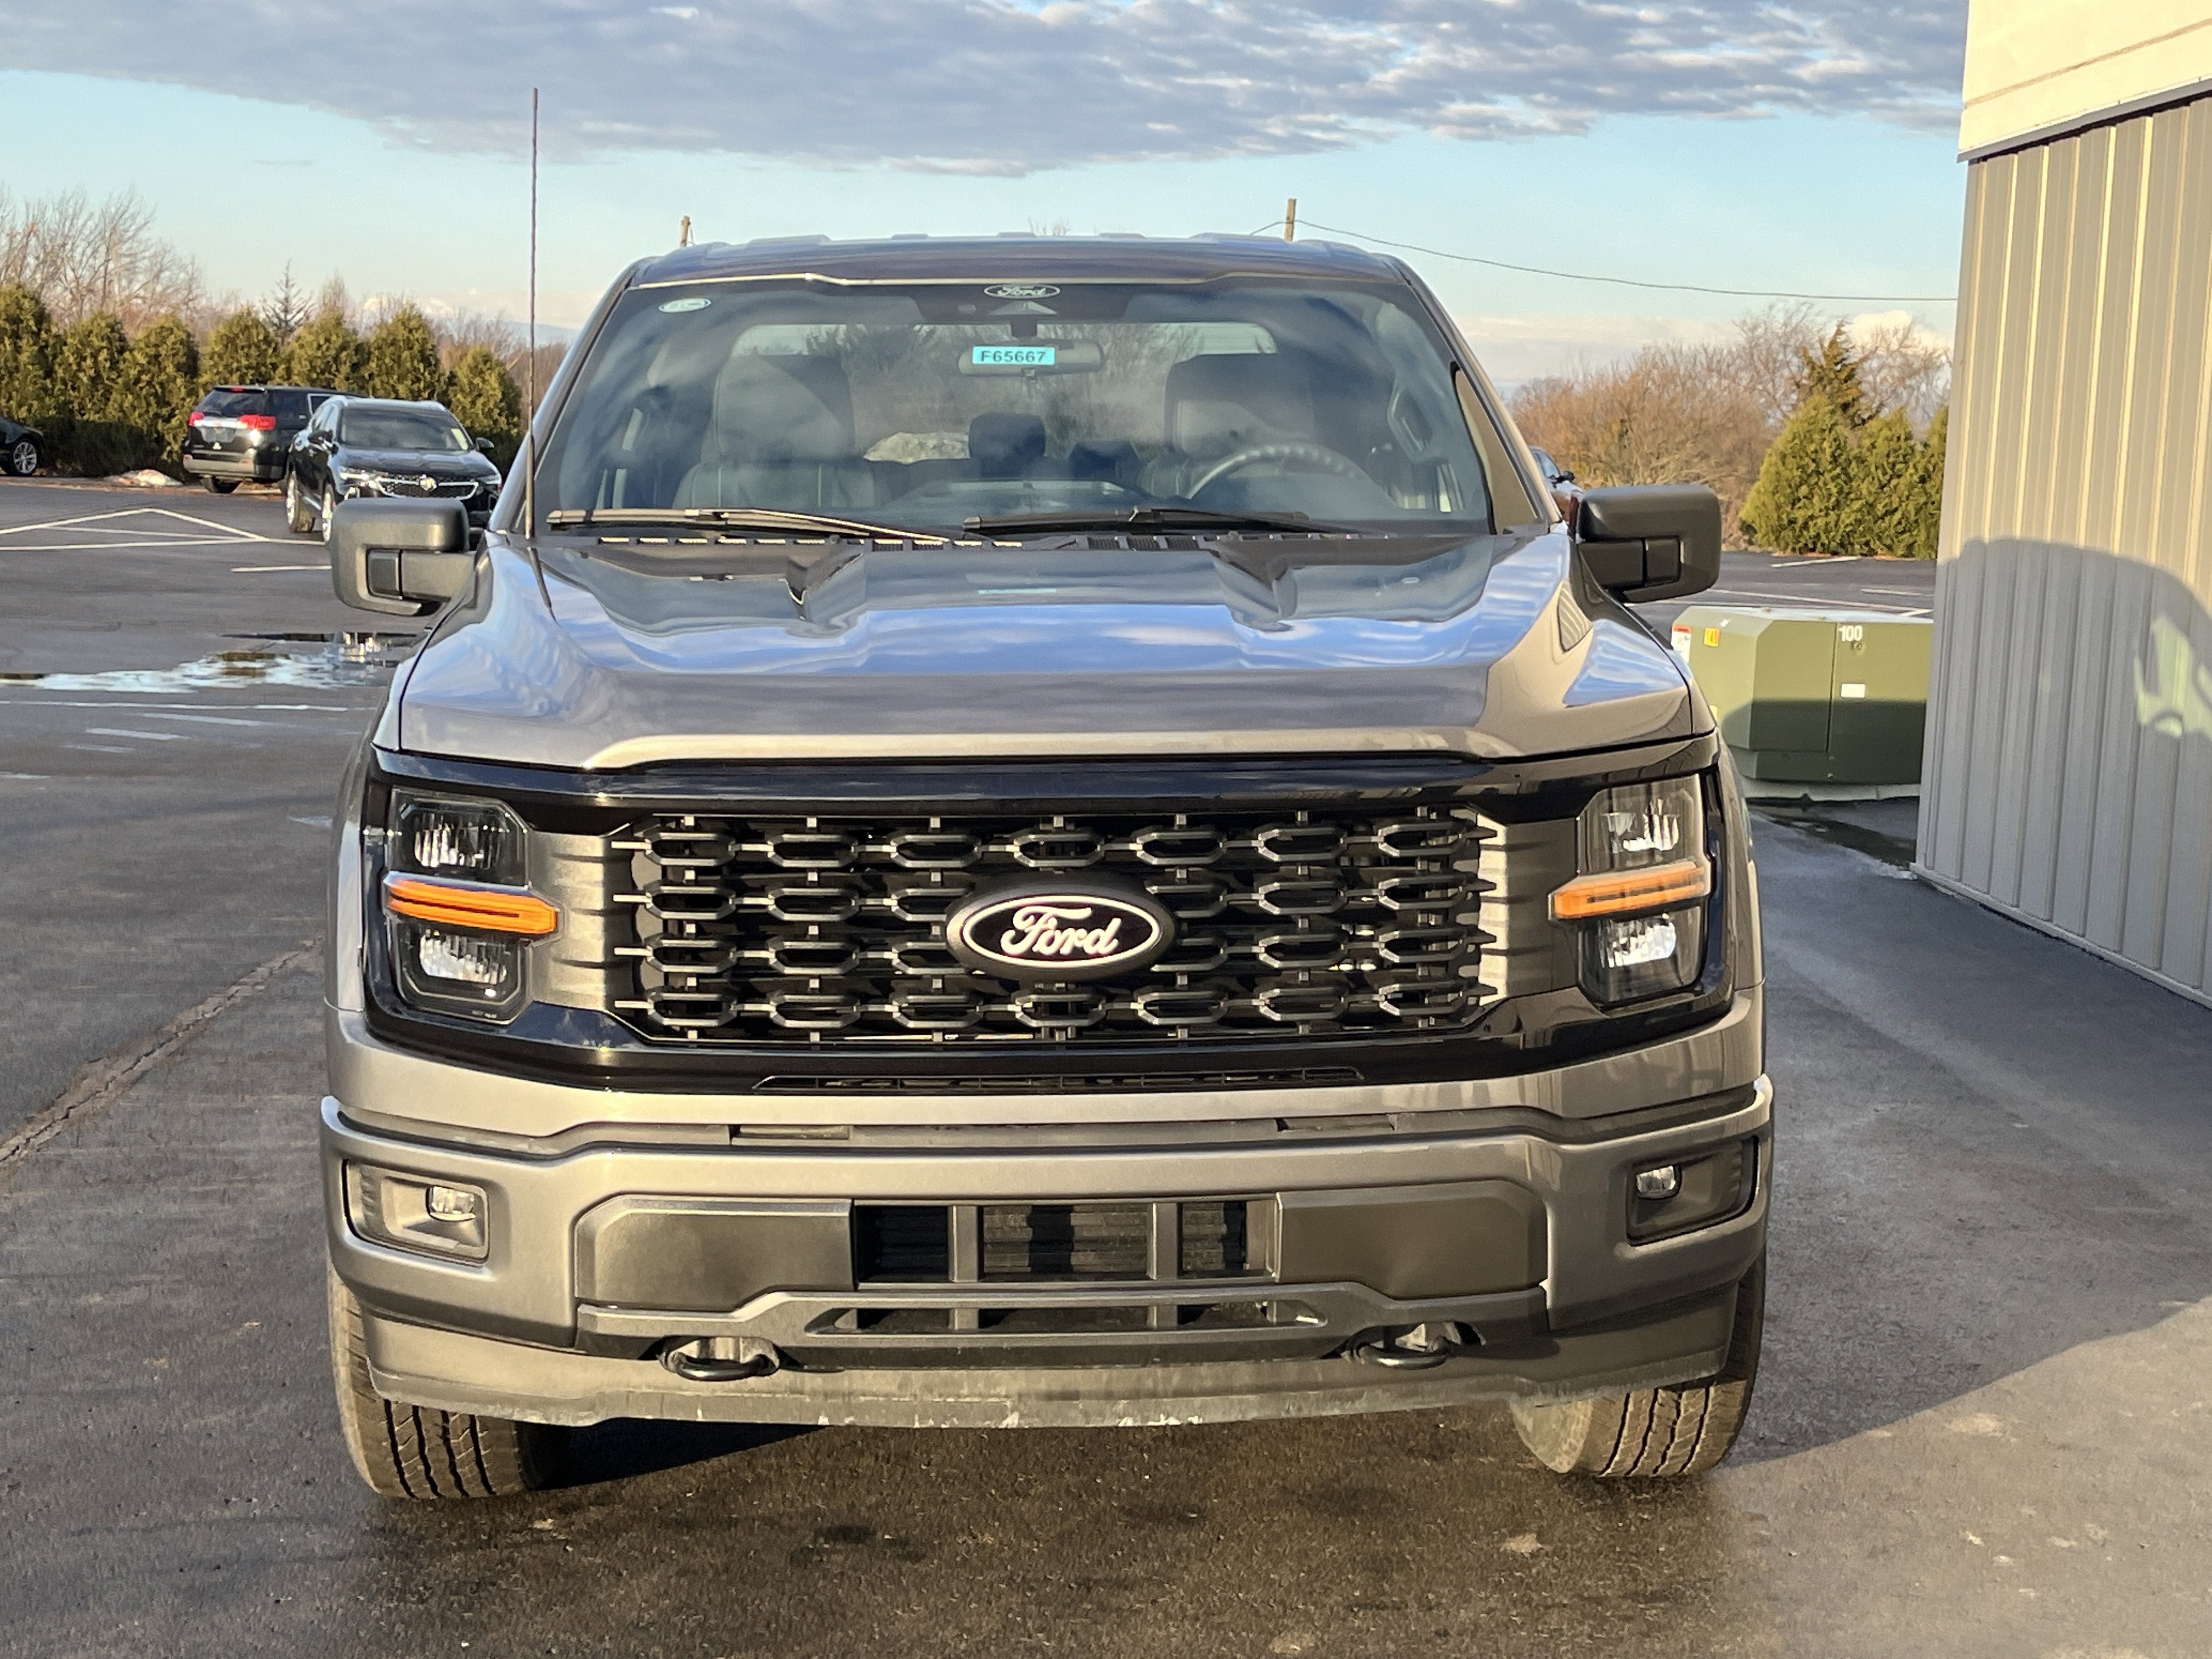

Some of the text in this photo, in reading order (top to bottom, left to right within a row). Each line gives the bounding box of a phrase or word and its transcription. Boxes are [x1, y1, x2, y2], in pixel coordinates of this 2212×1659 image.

[997, 285, 1047, 297] Ford
[980, 351, 1046, 362] F65667
[1838, 625, 1863, 641] 100
[1000, 905, 1122, 956] Ford
